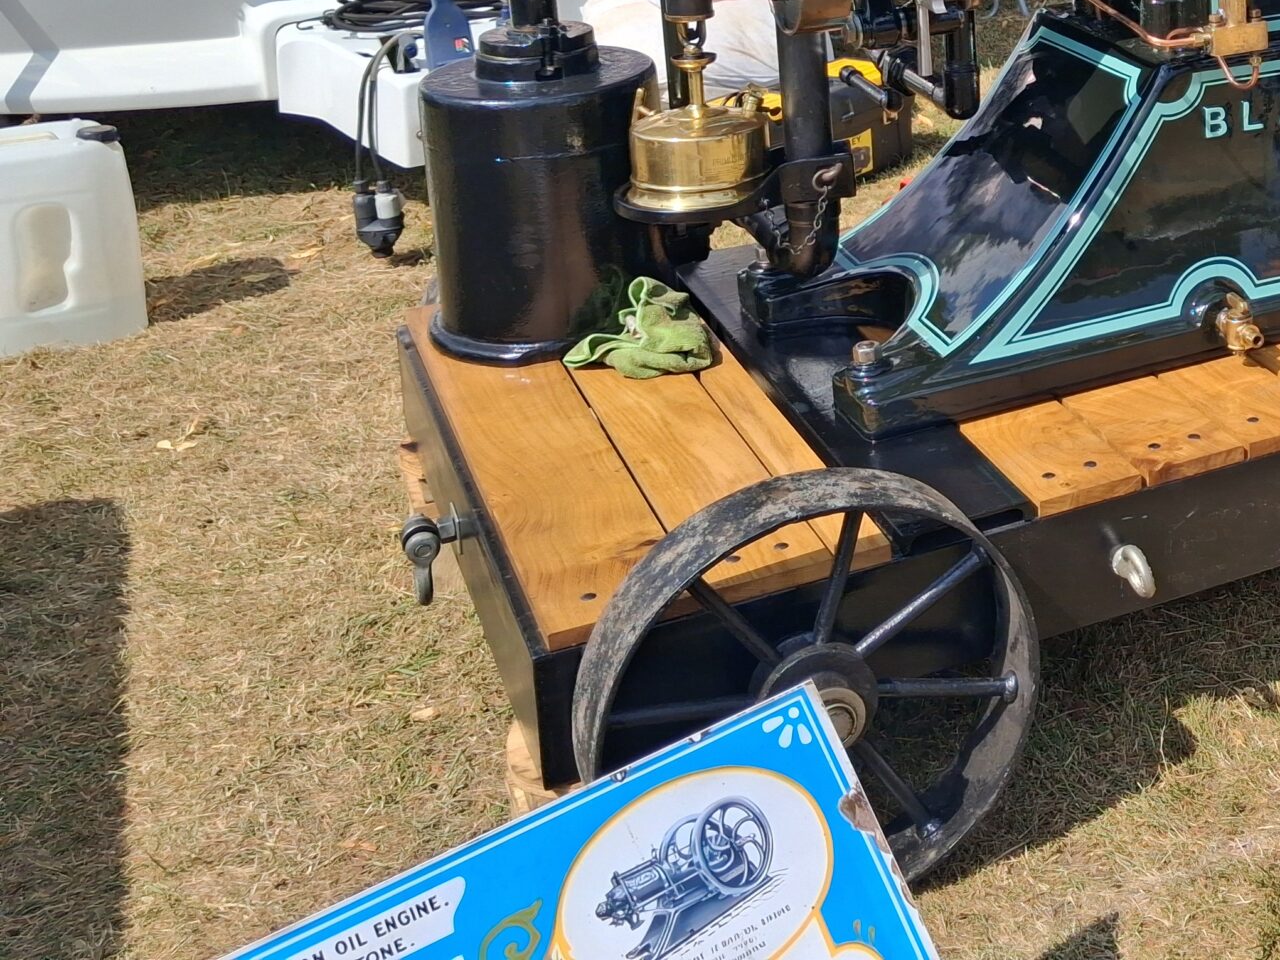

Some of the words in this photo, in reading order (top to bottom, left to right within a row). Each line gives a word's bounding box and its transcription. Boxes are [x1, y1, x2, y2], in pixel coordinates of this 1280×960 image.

[335, 933, 368, 955] OIL
[373, 895, 450, 938] ENGINE.
[355, 937, 415, 960] ONE.
